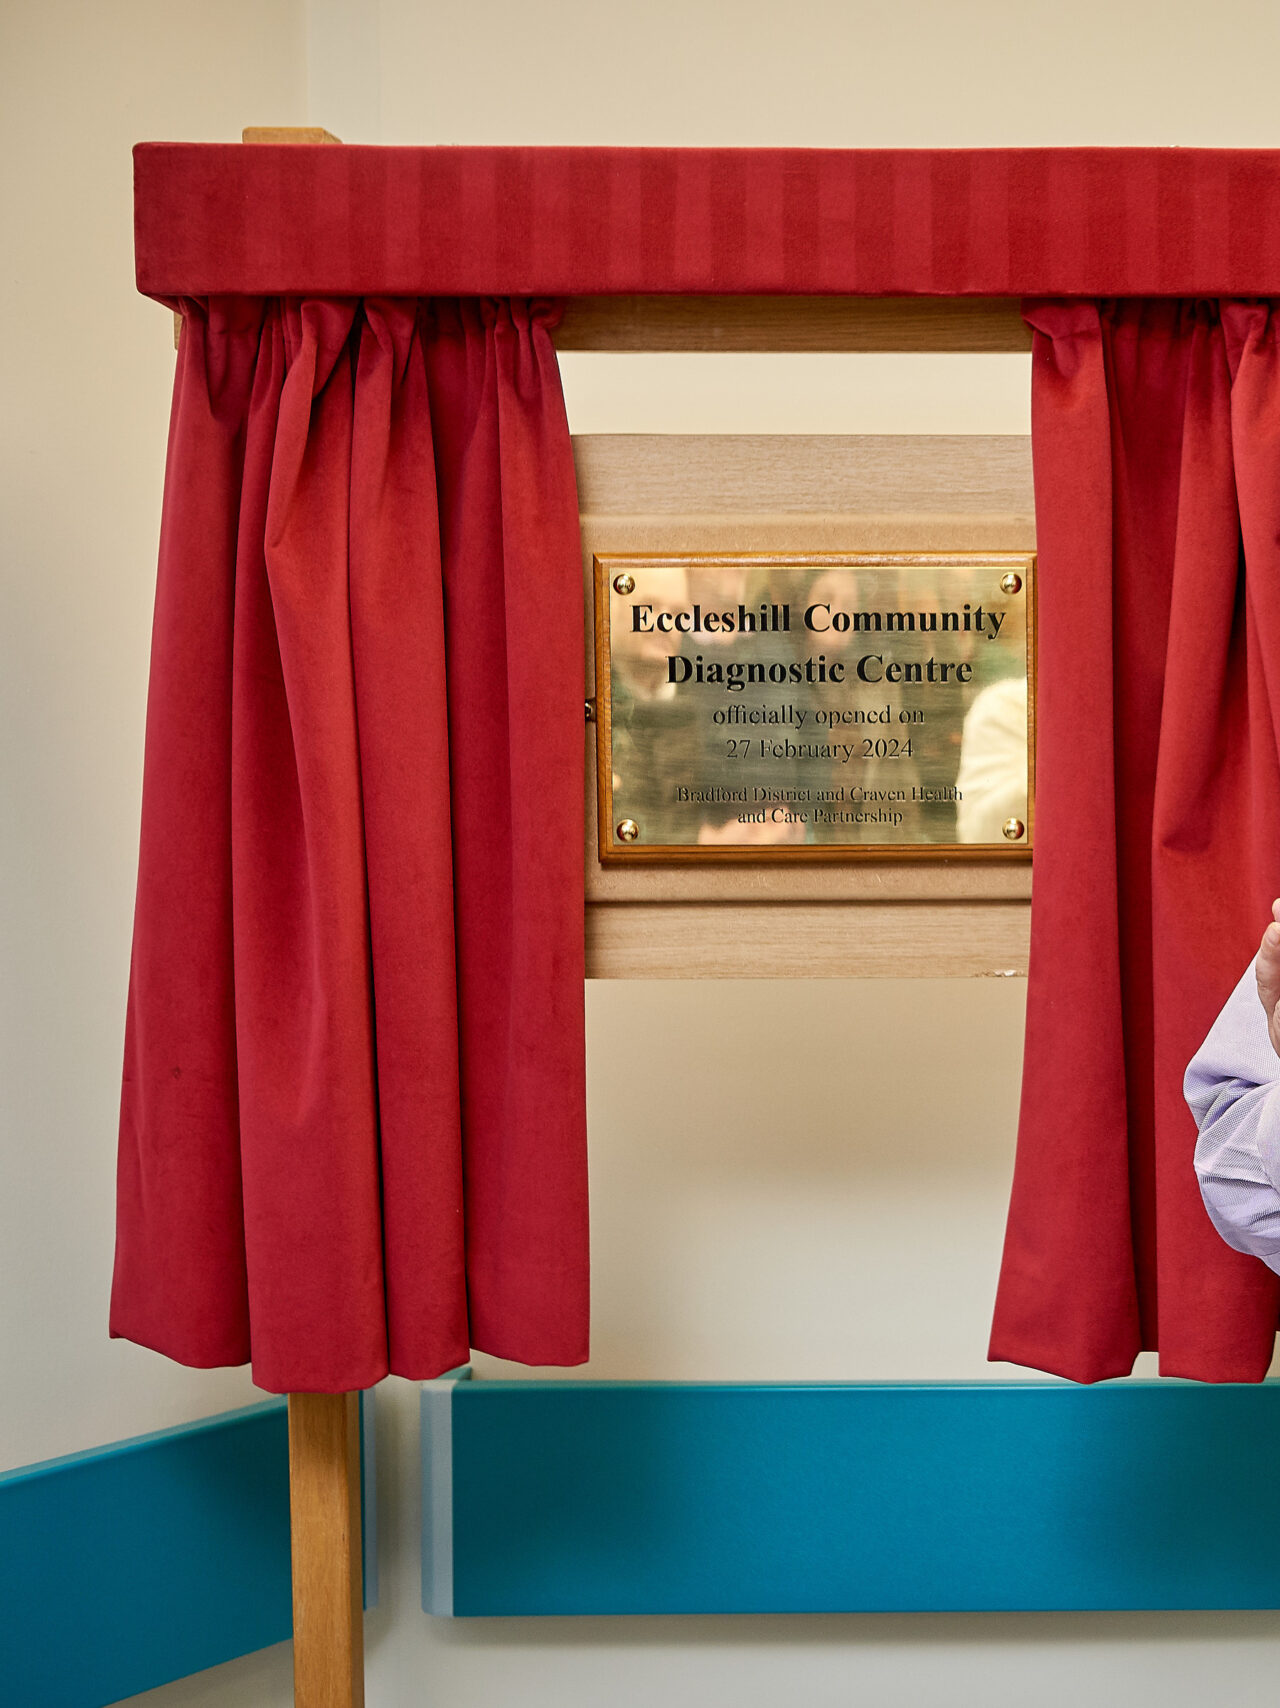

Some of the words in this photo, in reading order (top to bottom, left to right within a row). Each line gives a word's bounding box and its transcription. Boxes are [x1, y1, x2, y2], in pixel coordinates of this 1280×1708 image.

[631, 603, 791, 634] Eccleshill
[804, 603, 1007, 640] Community
[666, 655, 846, 691] Diagnostic
[856, 654, 974, 684] Centre
[712, 703, 808, 730] officially
[814, 704, 892, 725] opened
[898, 709, 925, 725] on
[726, 739, 751, 759] 27
[759, 738, 854, 763] February
[861, 738, 915, 759] 2024
[677, 786, 748, 802] Bradford
[753, 786, 812, 802] District
[816, 786, 845, 802] and
[849, 787, 906, 802] Craven
[911, 786, 964, 802] Health
[738, 808, 767, 824] and
[770, 809, 809, 824] Care
[813, 808, 904, 826] Partnership
